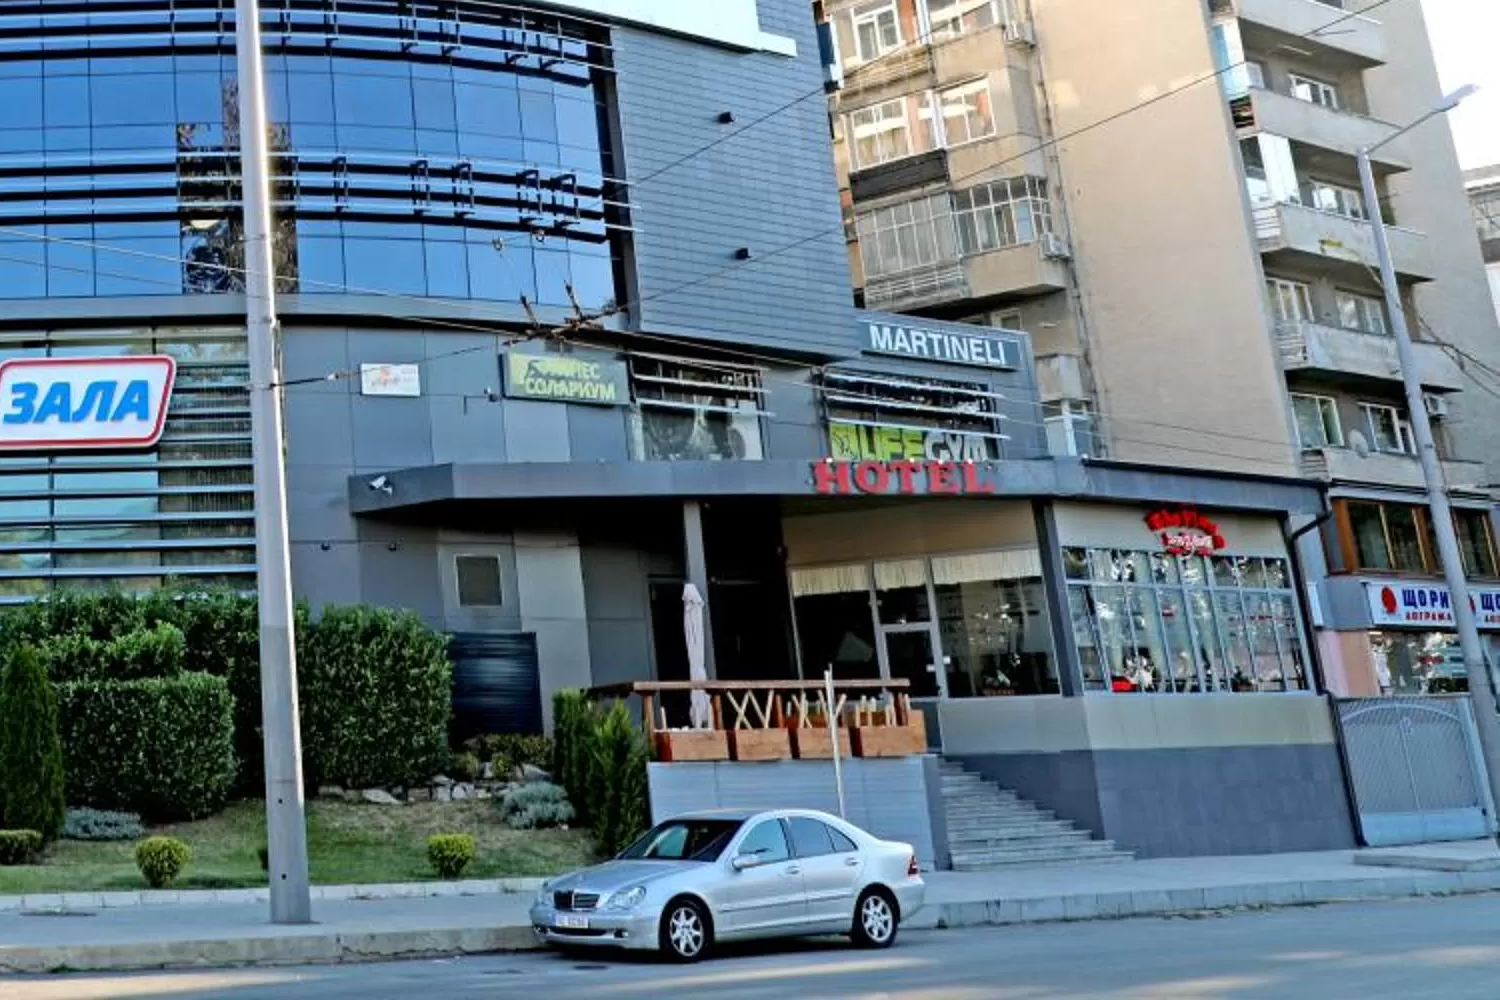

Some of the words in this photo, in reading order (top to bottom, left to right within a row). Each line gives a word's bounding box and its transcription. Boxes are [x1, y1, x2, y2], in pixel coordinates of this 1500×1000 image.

[869, 325, 1007, 364] MARTINELI
[2, 379, 151, 425] ЗАЛА
[525, 378, 615, 401] СОЛАРИУМ
[813, 460, 996, 494] HOTEL
[1402, 588, 1449, 609] ЩОРИ
